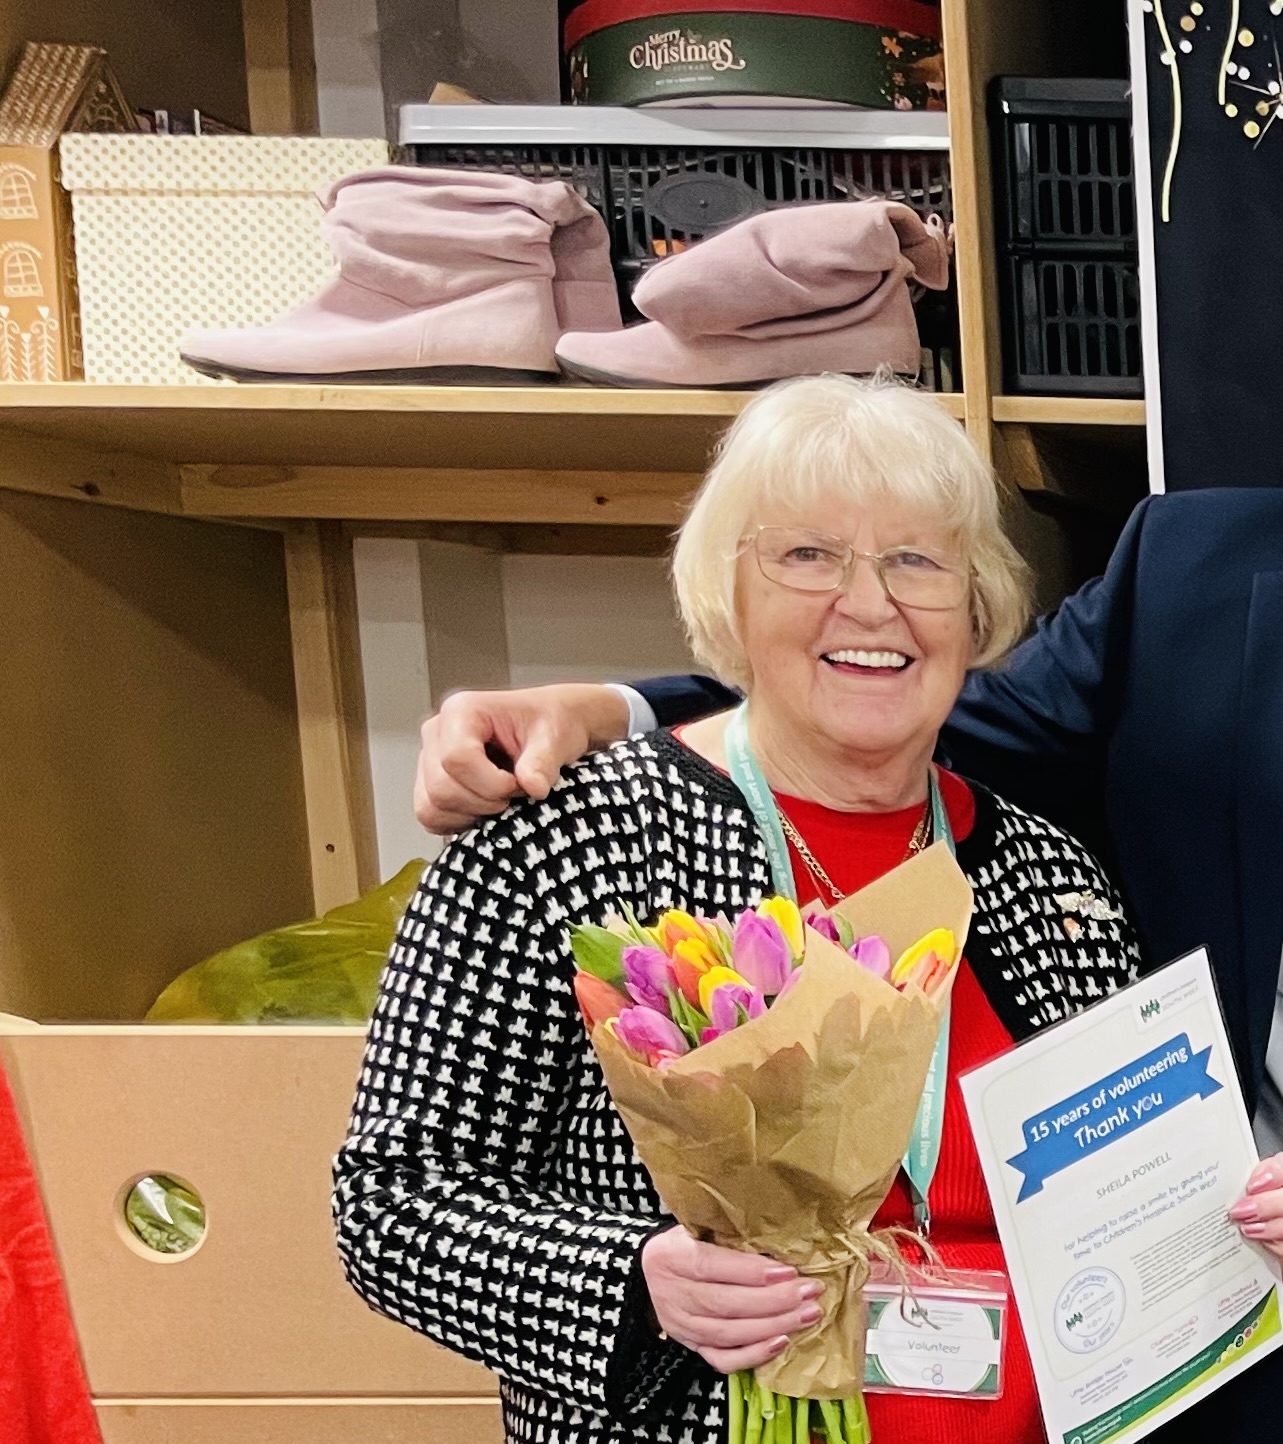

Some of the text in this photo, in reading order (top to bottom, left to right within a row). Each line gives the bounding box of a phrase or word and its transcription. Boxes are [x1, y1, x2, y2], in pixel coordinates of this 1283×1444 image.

[629, 37, 746, 71] Christmas
[649, 29, 681, 46] Merry
[920, 1093, 933, 1138] precious
[1030, 1047, 1188, 1142] 15 years of volunteering
[1073, 1092, 1163, 1148] Thank you
[920, 1140, 931, 1168] lives
[1096, 1152, 1172, 1199] SHEILA POWELL
[1077, 1223, 1108, 1245] helping
[1169, 1184, 1179, 1195] by
[908, 1340, 961, 1354] Volunteer
